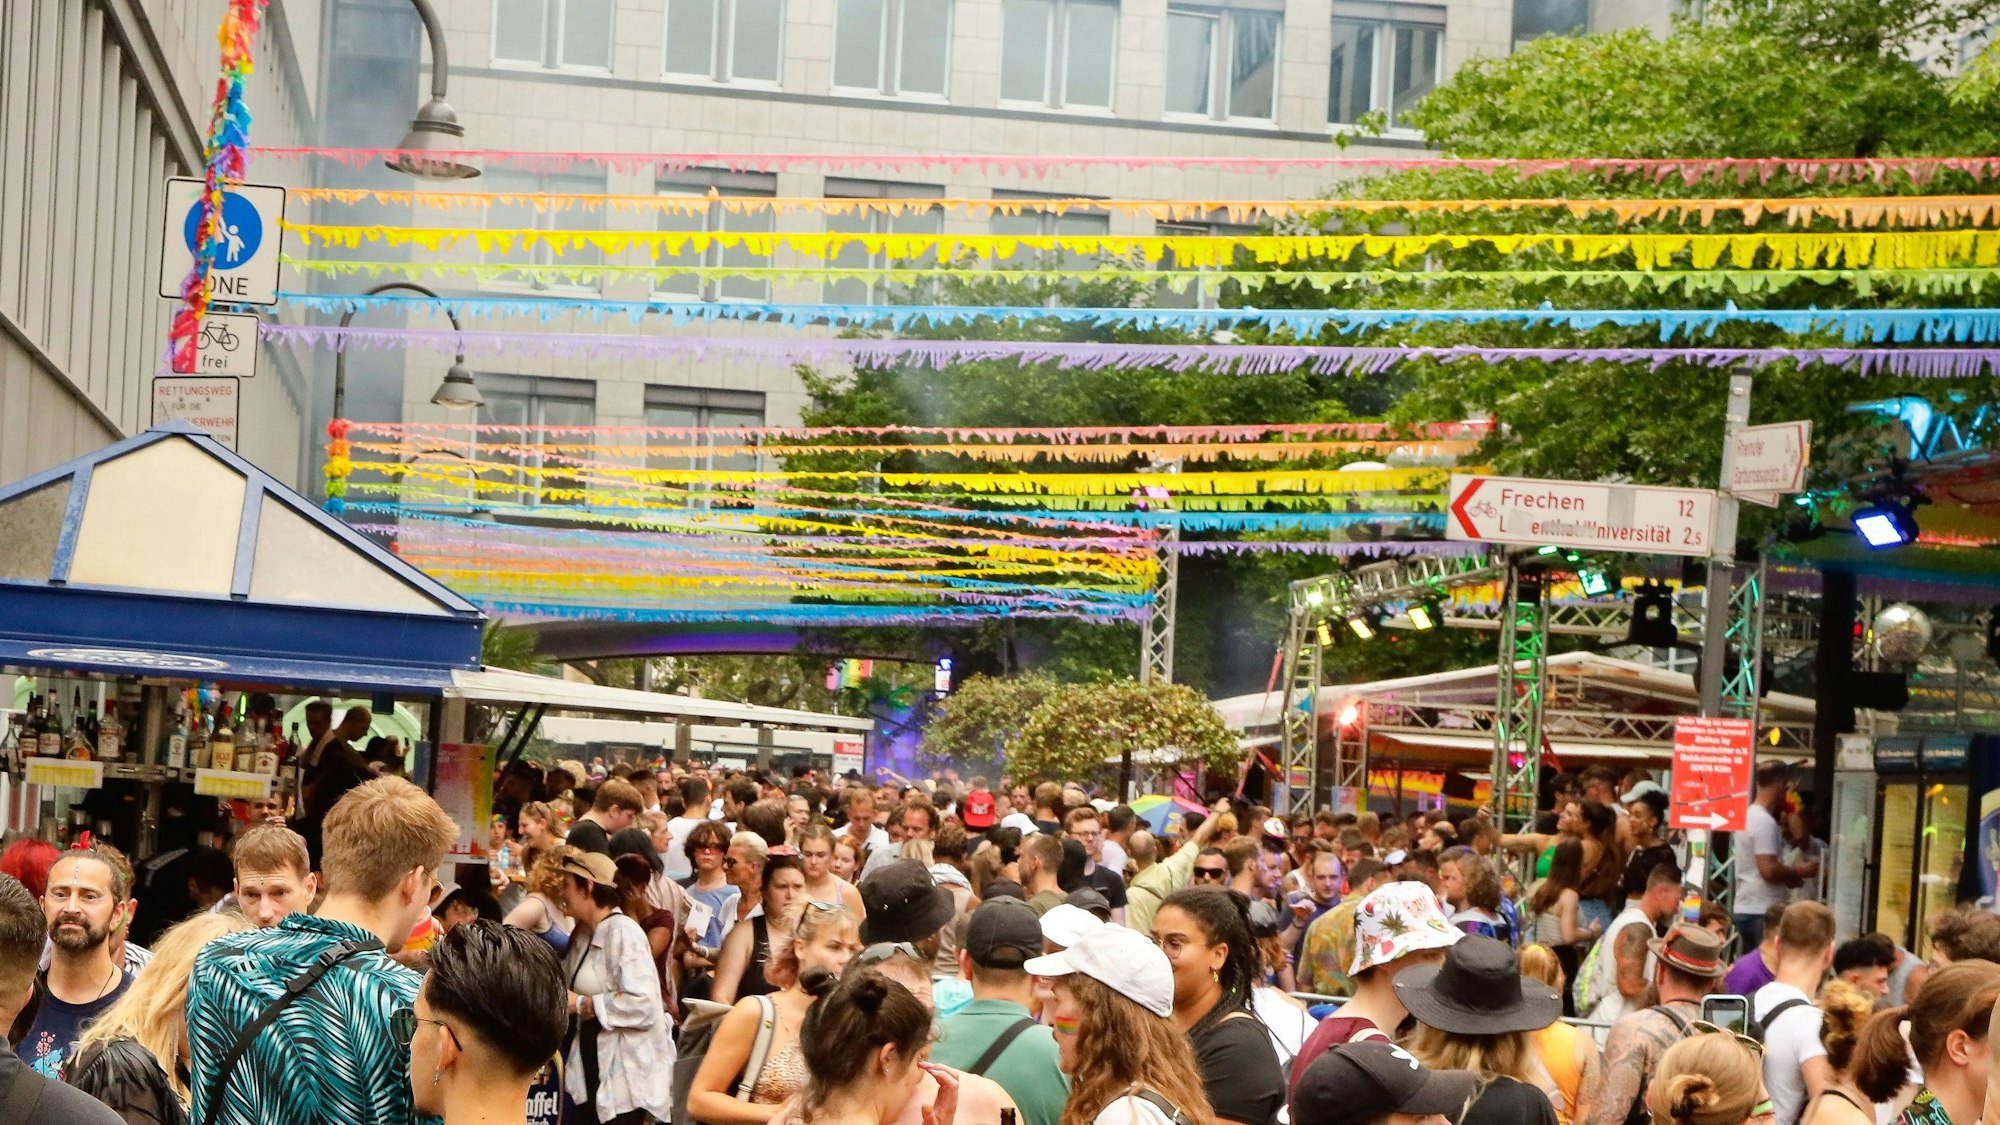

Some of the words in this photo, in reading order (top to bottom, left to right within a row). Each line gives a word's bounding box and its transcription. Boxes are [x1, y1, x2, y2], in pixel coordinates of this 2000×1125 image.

[210, 275, 248, 295] ONE
[202, 354, 228, 369] frei
[159, 386, 232, 396] RETTUNGSWEG
[190, 403, 201, 411] DIE
[1501, 488, 1584, 511] Frechen
[1679, 499, 1695, 518] 12
[526, 1091, 558, 1118] affel
